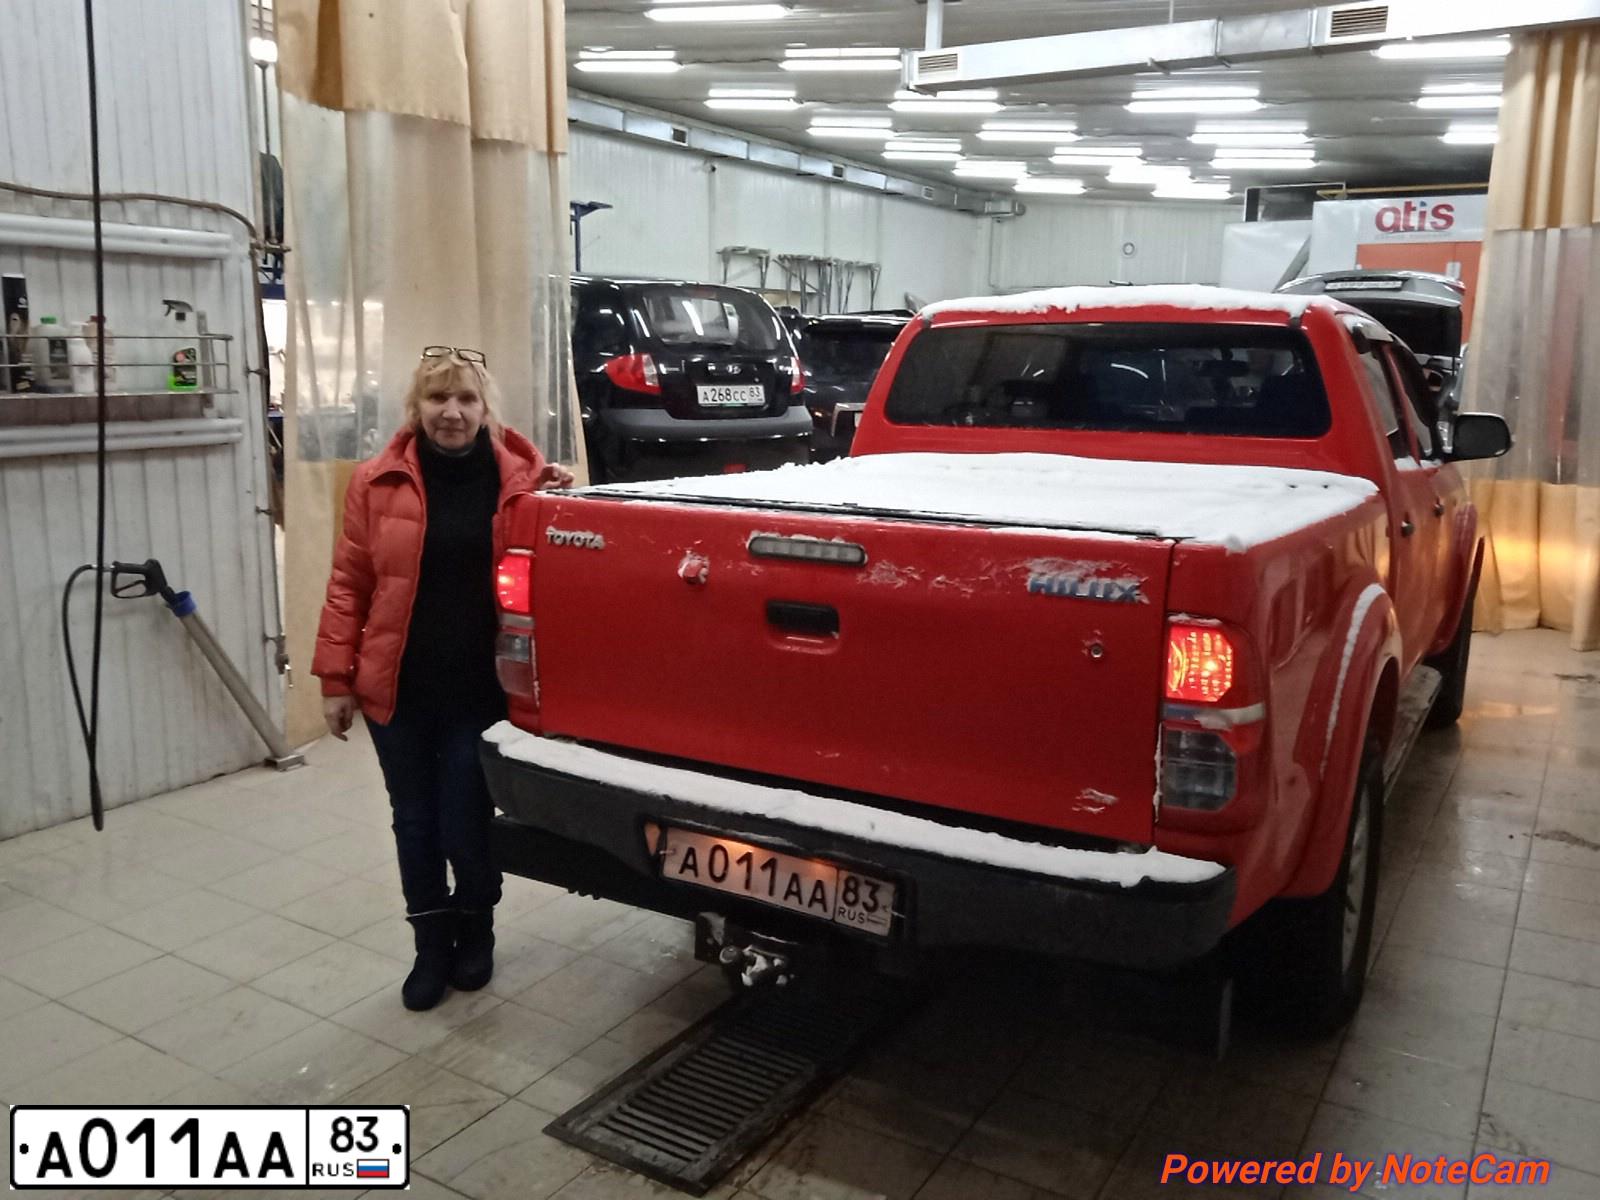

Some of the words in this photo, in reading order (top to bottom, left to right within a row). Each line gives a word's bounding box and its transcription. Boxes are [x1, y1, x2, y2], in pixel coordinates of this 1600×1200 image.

[546, 526, 605, 549] TOYOTA
[841, 875, 880, 914] 83
[838, 906, 865, 925] RUS
